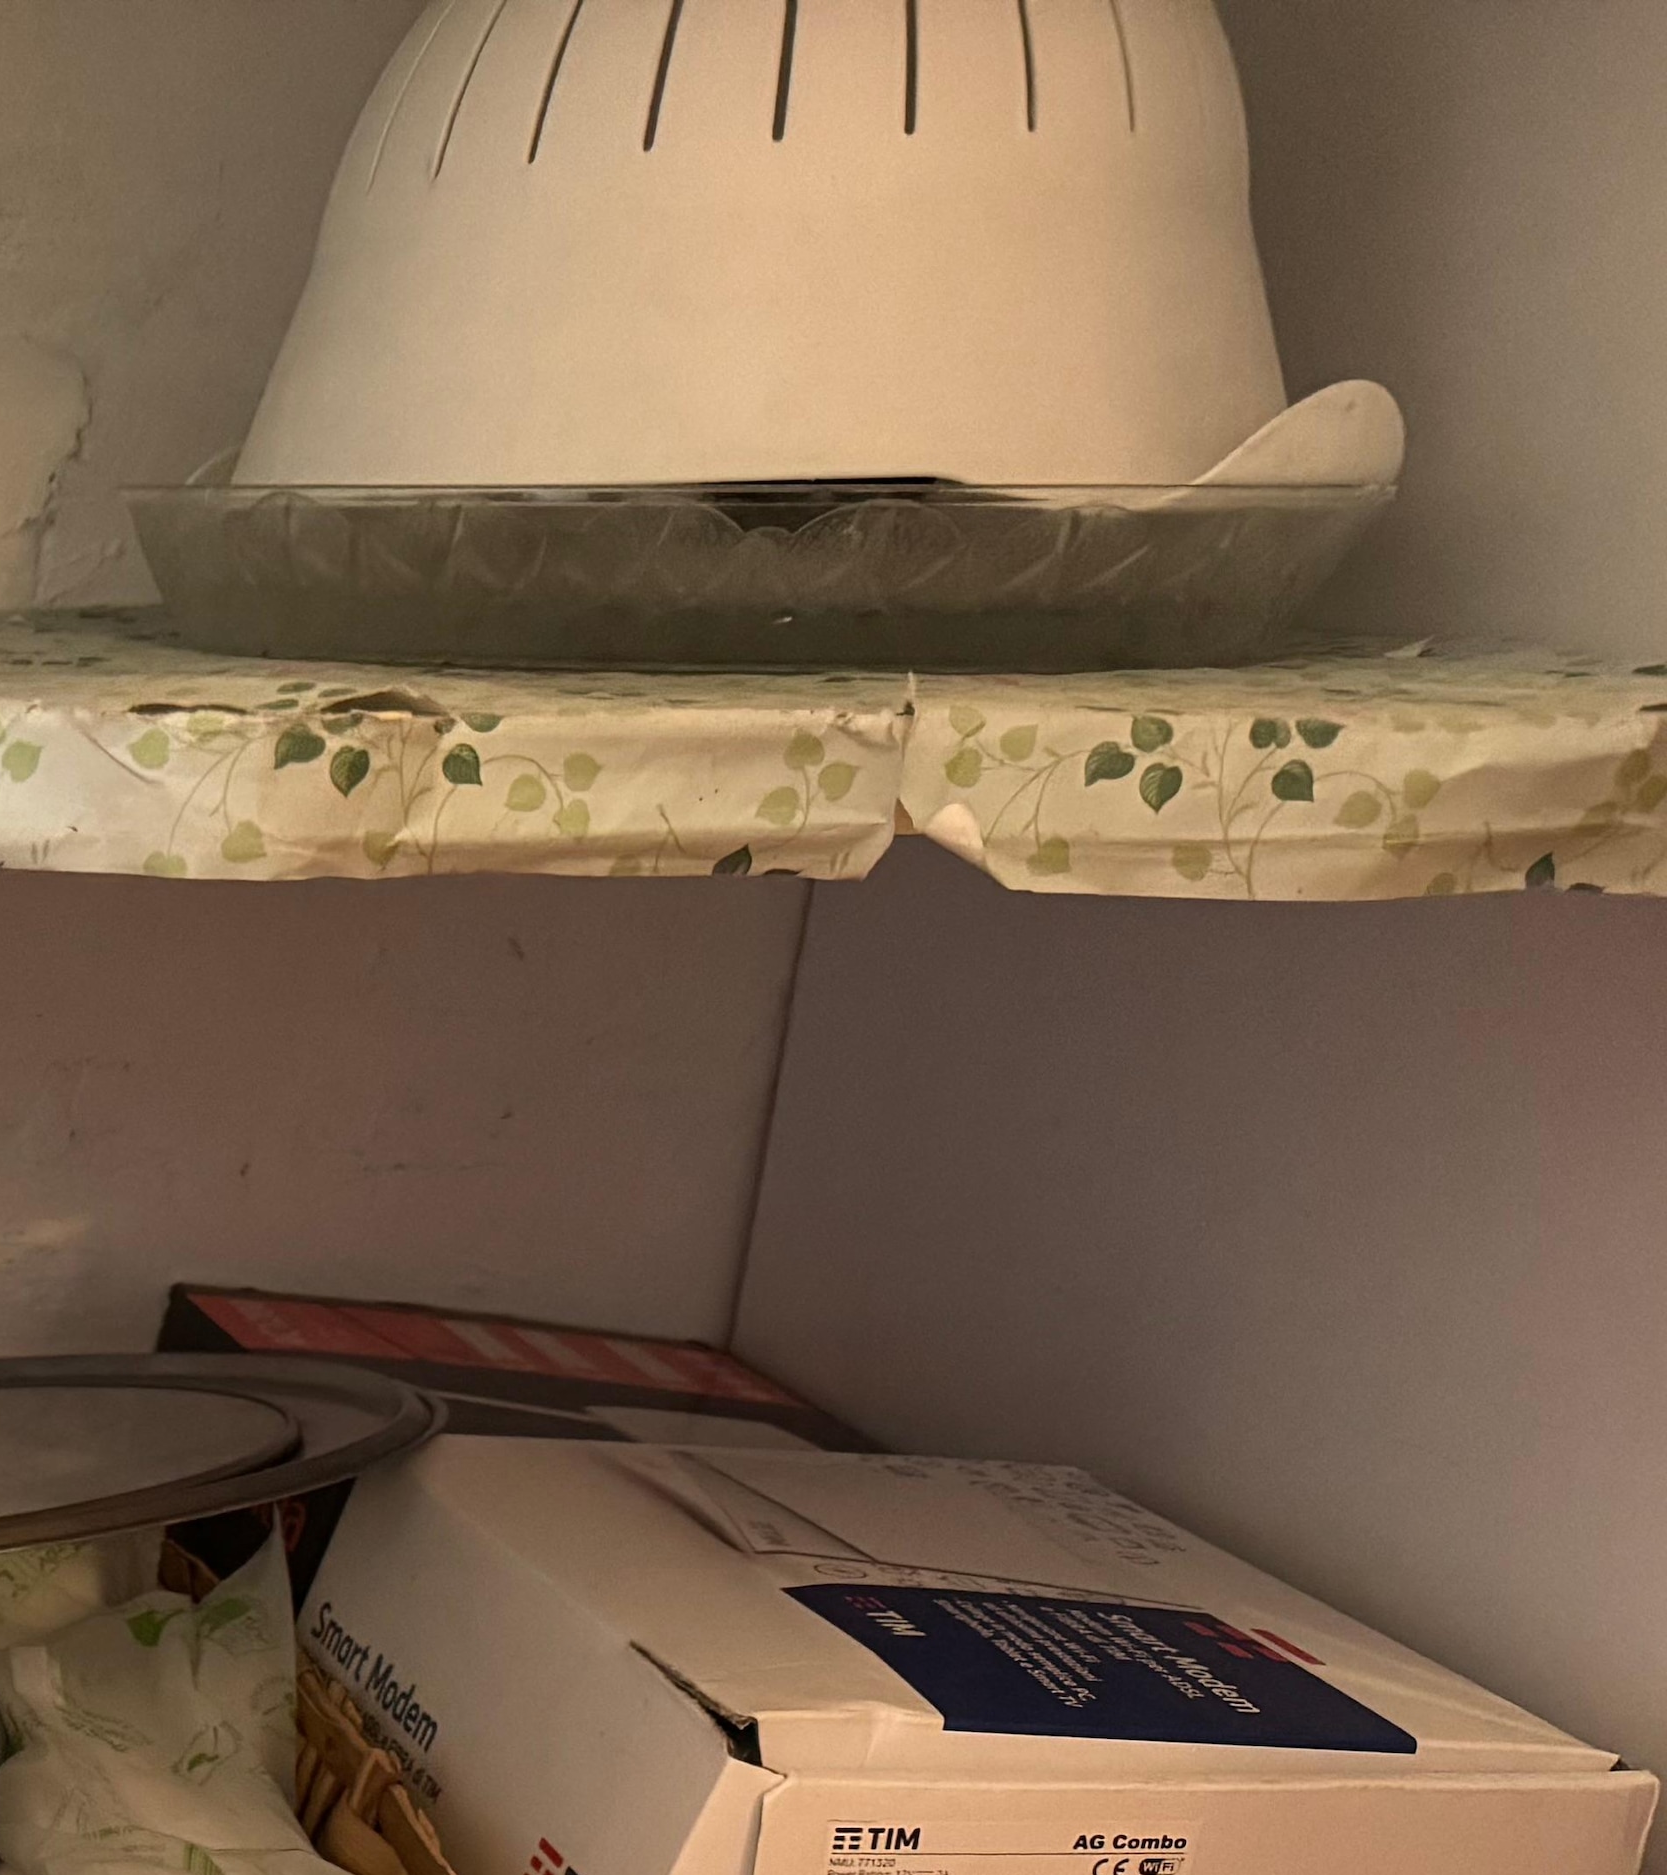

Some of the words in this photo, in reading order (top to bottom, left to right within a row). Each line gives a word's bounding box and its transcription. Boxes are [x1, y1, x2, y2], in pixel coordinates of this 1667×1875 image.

[867, 1610, 926, 1637] TIM
[1098, 1613, 1178, 1653] Smart
[1164, 1656, 1260, 1712] Modem
[310, 1602, 369, 1683] Smart
[366, 1653, 439, 1752] Modem
[1162, 1675, 1204, 1698] ADSL
[1059, 1696, 1083, 1707] TV
[867, 1827, 922, 1850] TIM
[1072, 1834, 1106, 1850] AG
[1112, 1834, 1188, 1850] Combo
